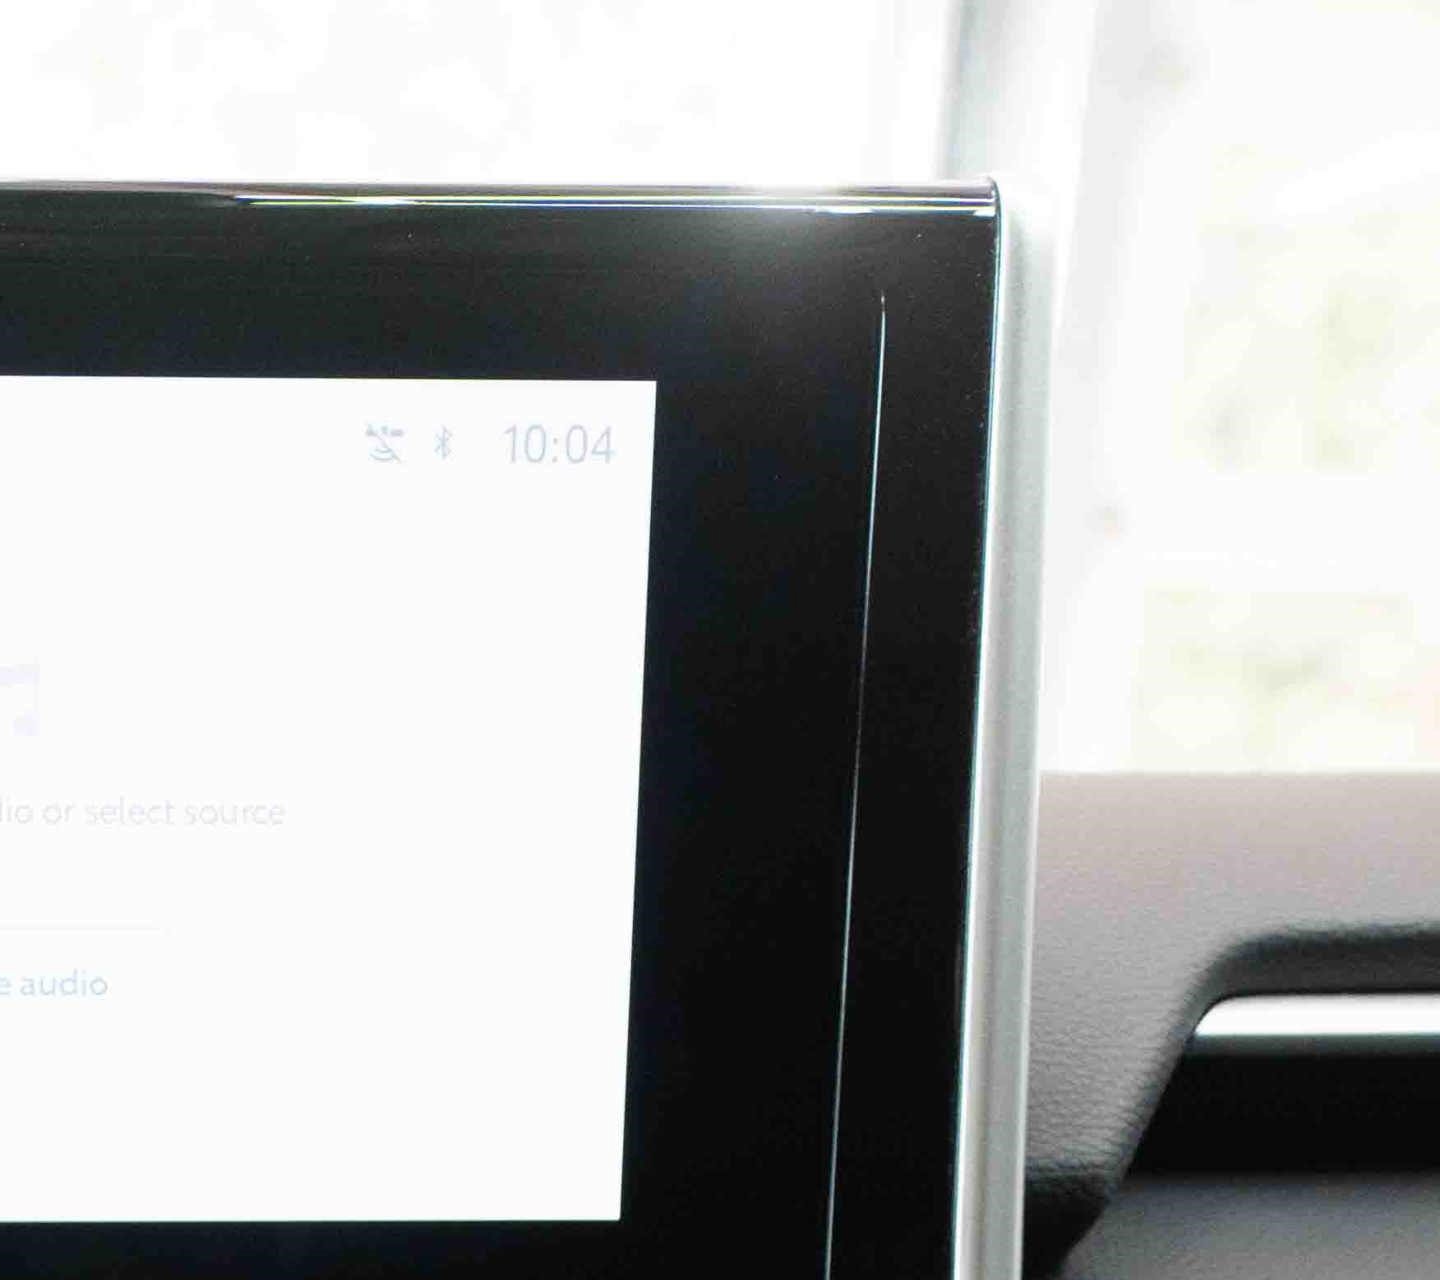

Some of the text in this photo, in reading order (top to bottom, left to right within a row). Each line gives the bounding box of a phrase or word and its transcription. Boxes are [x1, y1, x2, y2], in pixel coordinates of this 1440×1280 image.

[504, 423, 616, 465] 10:04
[41, 803, 75, 825] or
[84, 795, 176, 826] select
[184, 803, 287, 826] source
[19, 968, 109, 998] audio
